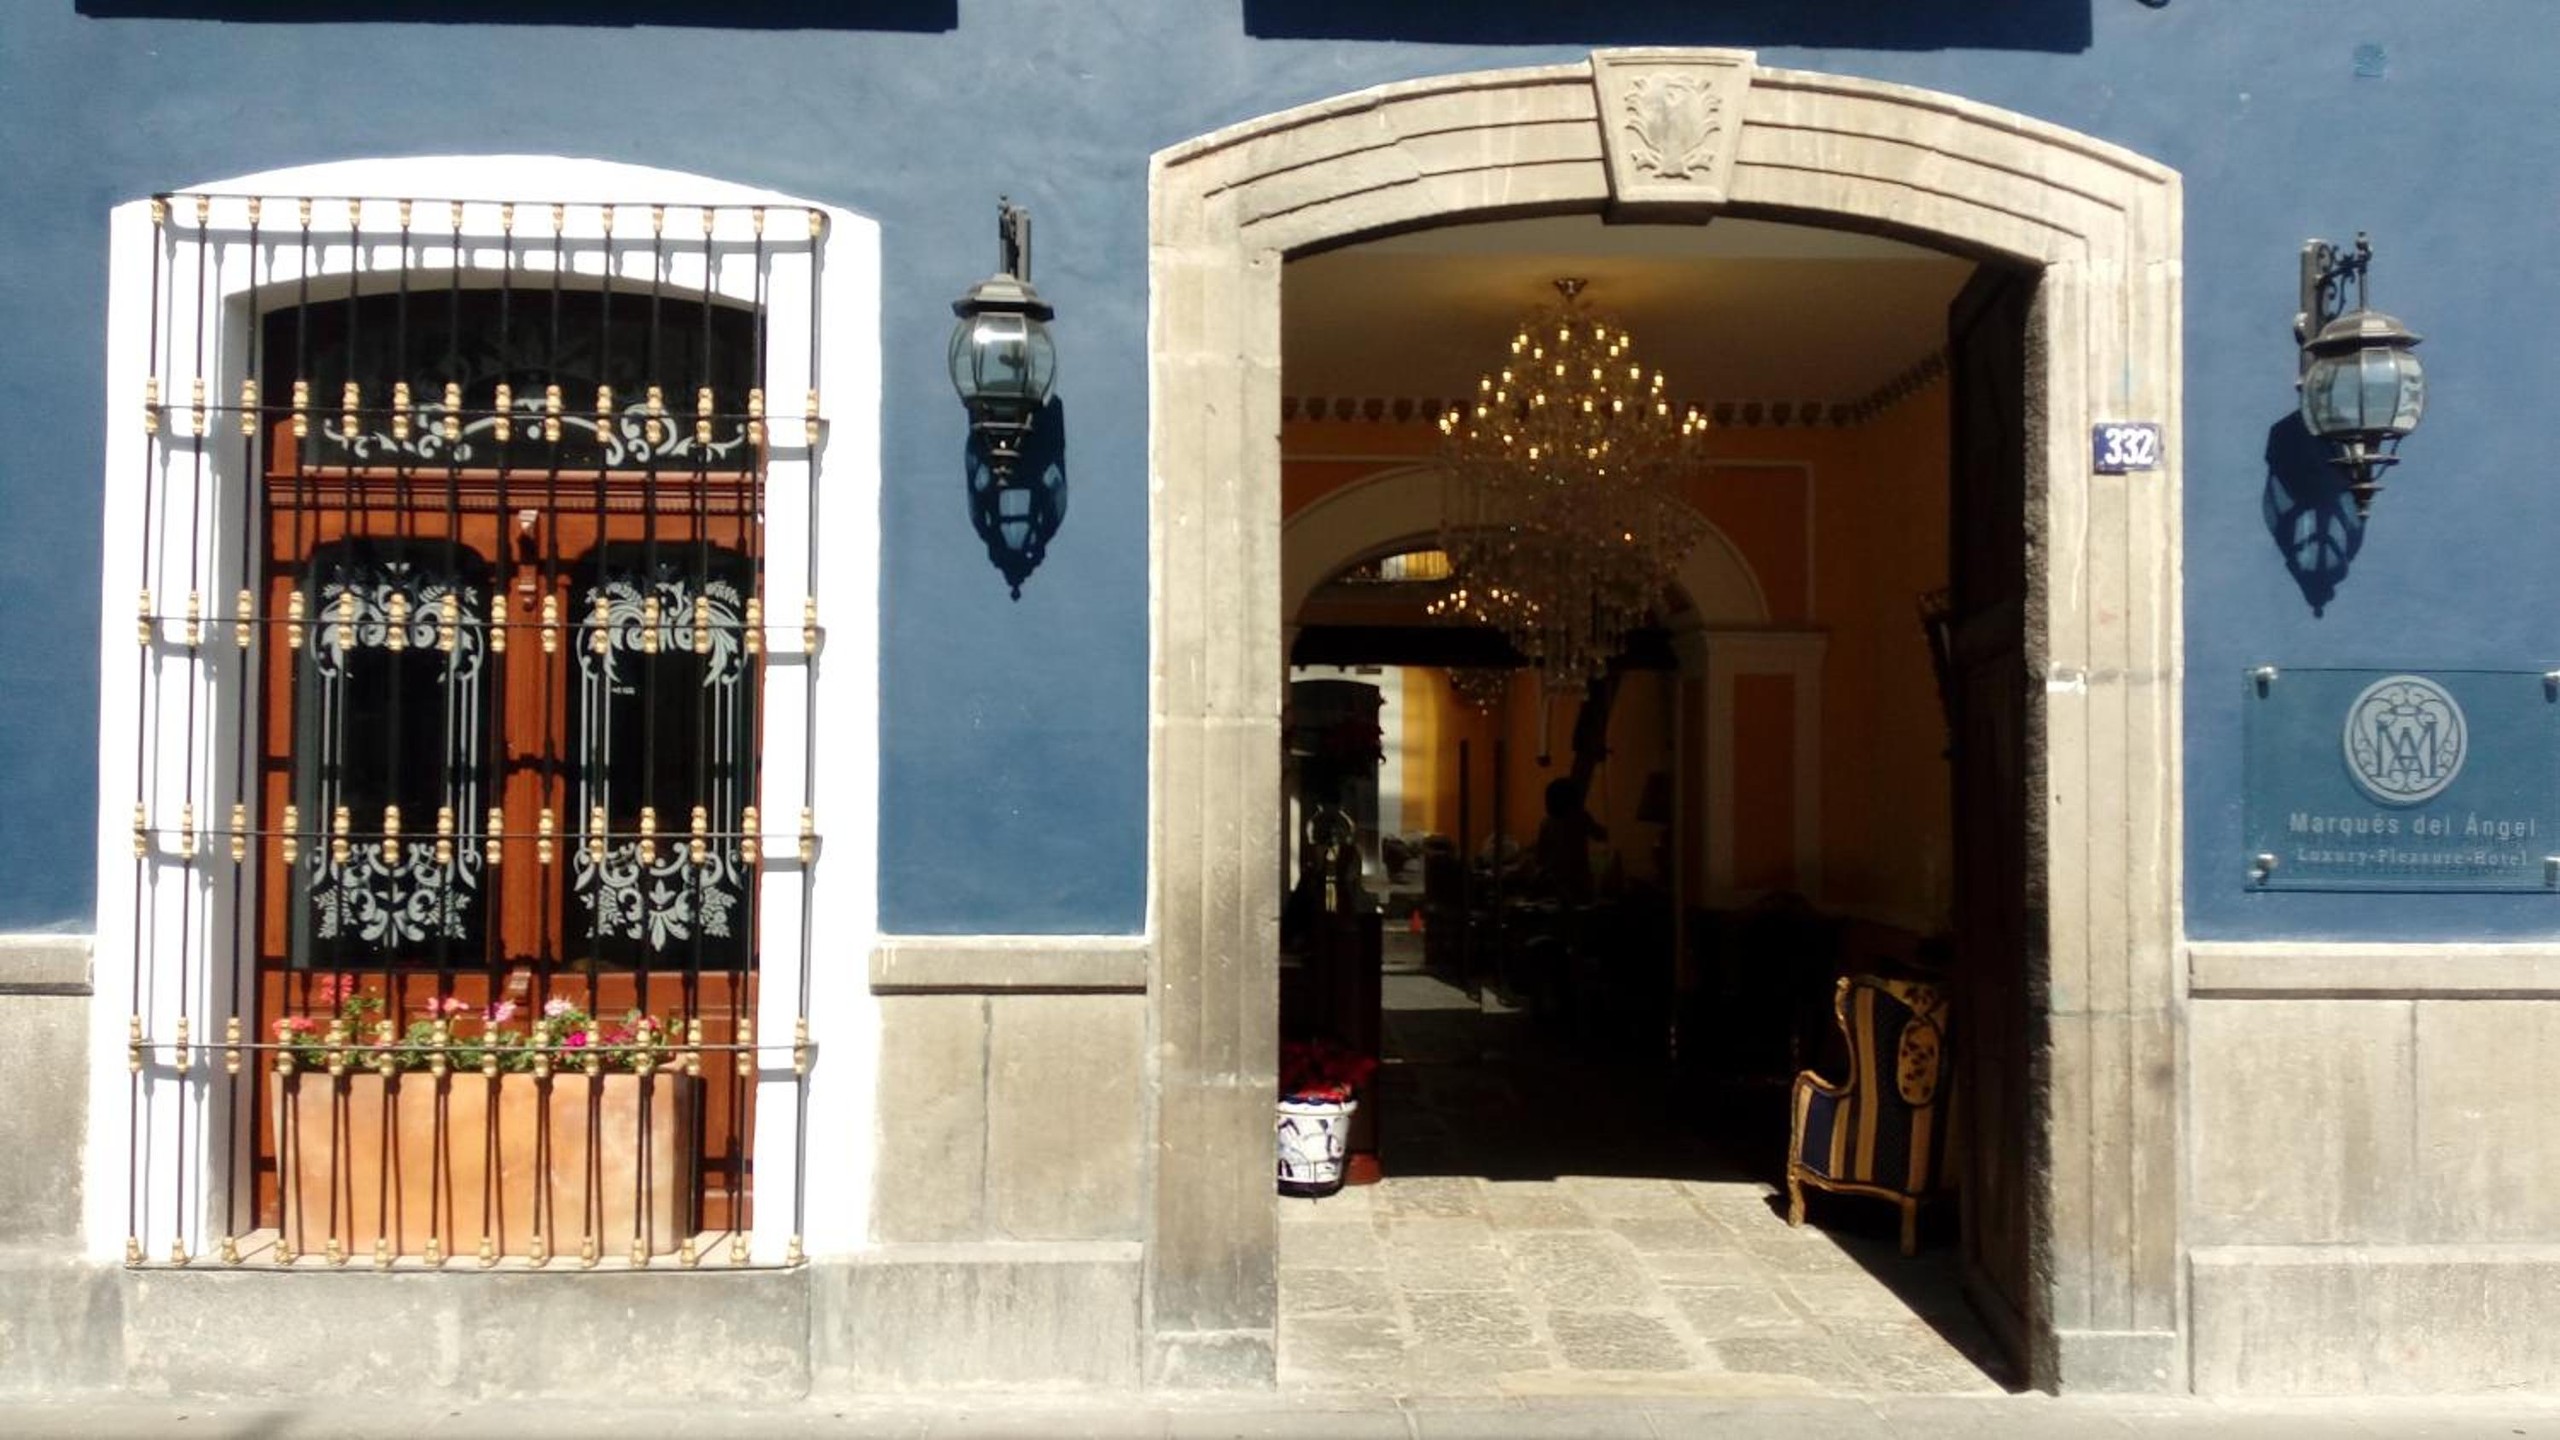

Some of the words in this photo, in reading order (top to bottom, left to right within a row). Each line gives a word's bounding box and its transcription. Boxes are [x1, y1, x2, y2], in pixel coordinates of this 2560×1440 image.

[2104, 427, 2155, 465] 332
[2290, 812, 2399, 837] Marqués
[2413, 814, 2450, 836] del
[2465, 810, 2535, 840] Ángel
